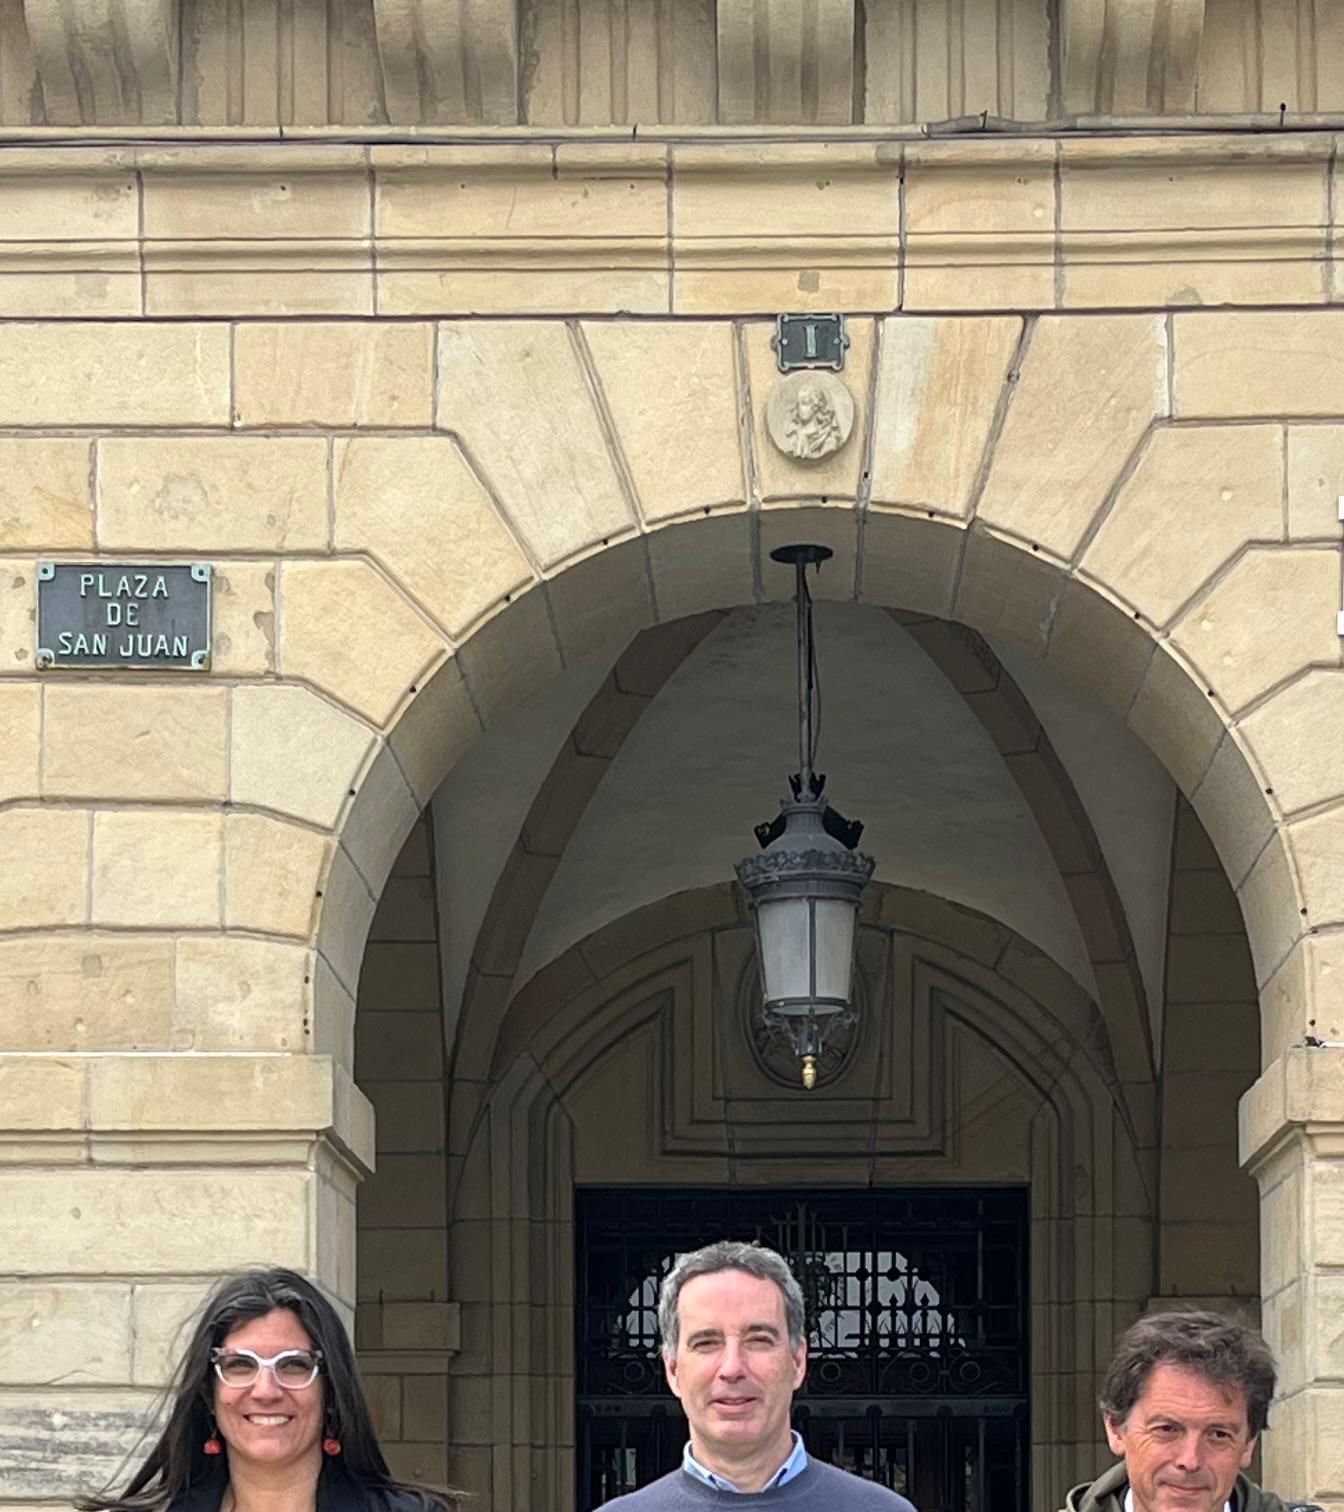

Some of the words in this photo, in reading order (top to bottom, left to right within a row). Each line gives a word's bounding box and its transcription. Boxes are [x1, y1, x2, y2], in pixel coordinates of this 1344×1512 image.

[79, 573, 169, 598] PLAZA
[106, 602, 140, 626] DE
[58, 632, 107, 656] SAN
[119, 633, 189, 657] JUAN
